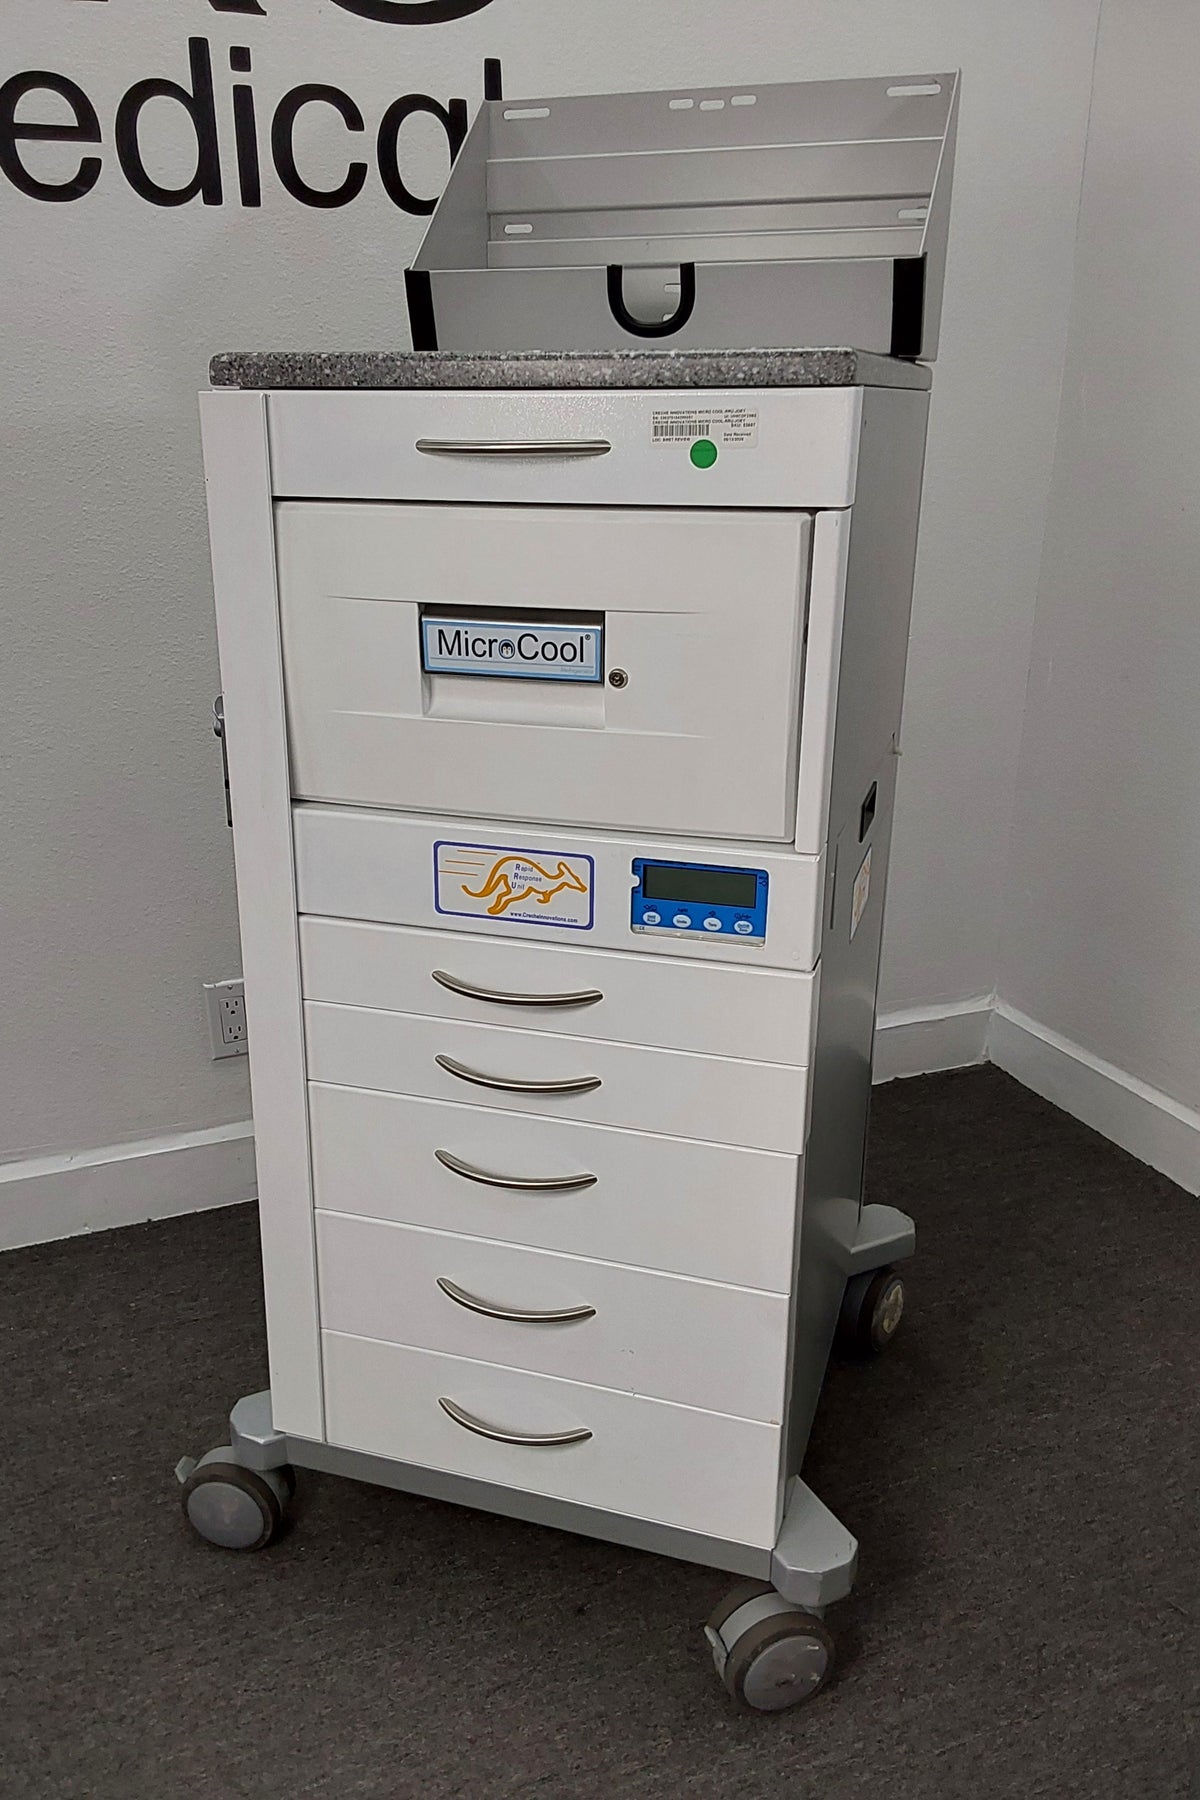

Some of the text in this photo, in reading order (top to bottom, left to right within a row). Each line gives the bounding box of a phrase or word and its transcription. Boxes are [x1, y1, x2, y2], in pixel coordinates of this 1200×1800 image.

[0, 37, 502, 216] edica
[515, 863, 534, 872] Rapid
[513, 872, 542, 882] Response
[511, 881, 525, 890] Unit
